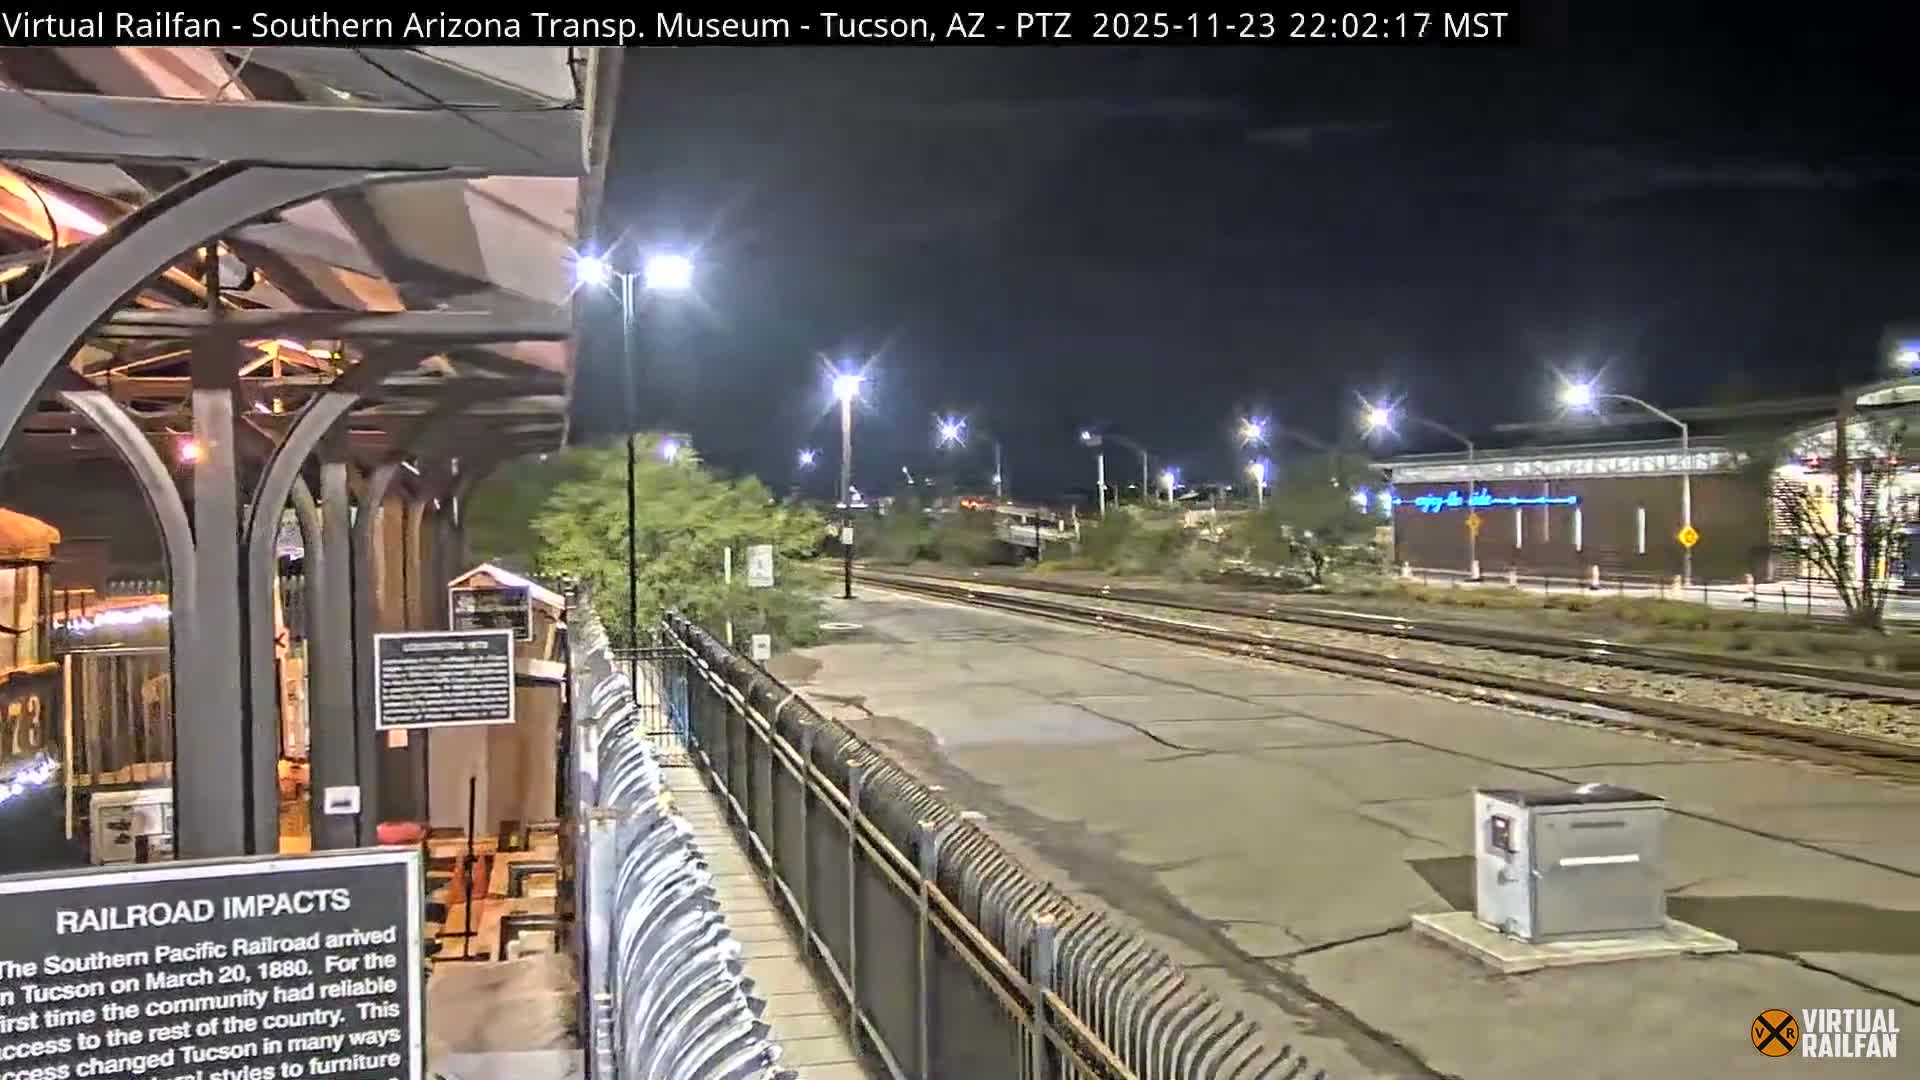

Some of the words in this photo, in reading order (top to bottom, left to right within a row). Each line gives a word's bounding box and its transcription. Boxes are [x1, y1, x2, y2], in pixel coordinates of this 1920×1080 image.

[56, 899, 215, 935] RAILROAD
[223, 888, 351, 920] IMPACTS
[0, 960, 38, 980] The
[44, 951, 149, 976] Southern
[155, 940, 227, 965] Pacific
[232, 932, 320, 957] Railroad
[325, 926, 397, 949] arrived
[0, 990, 15, 1007] n
[20, 981, 105, 1005] Tucson
[110, 977, 140, 994] on
[145, 967, 214, 991] March
[218, 965, 252, 984] 20,
[258, 959, 313, 980] 1880.
[325, 955, 359, 974] For
[364, 952, 397, 970] the
[0, 1011, 39, 1034] irst
[44, 1009, 96, 1028] time
[102, 1002, 140, 1022] the
[145, 987, 269, 1017] community
[273, 982, 315, 1003] had
[319, 976, 397, 999] reliable
[0, 1038, 72, 1061] ccess
[77, 1032, 101, 1051] to
[106, 1028, 143, 1047] the
[148, 1021, 192, 1042] rest
[196, 1017, 219, 1037] of
[223, 1015, 257, 1033] the
[262, 1008, 346, 1030] country.
[356, 1000, 400, 1020] This
[0, 1064, 71, 1080] ccess
[76, 1047, 175, 1078] changed
[178, 1041, 258, 1064] Tucson
[263, 1037, 283, 1055] in
[287, 1033, 344, 1053] many
[348, 1027, 400, 1048] ways
[280, 1061, 304, 1079] to
[308, 1052, 401, 1075] furniture
